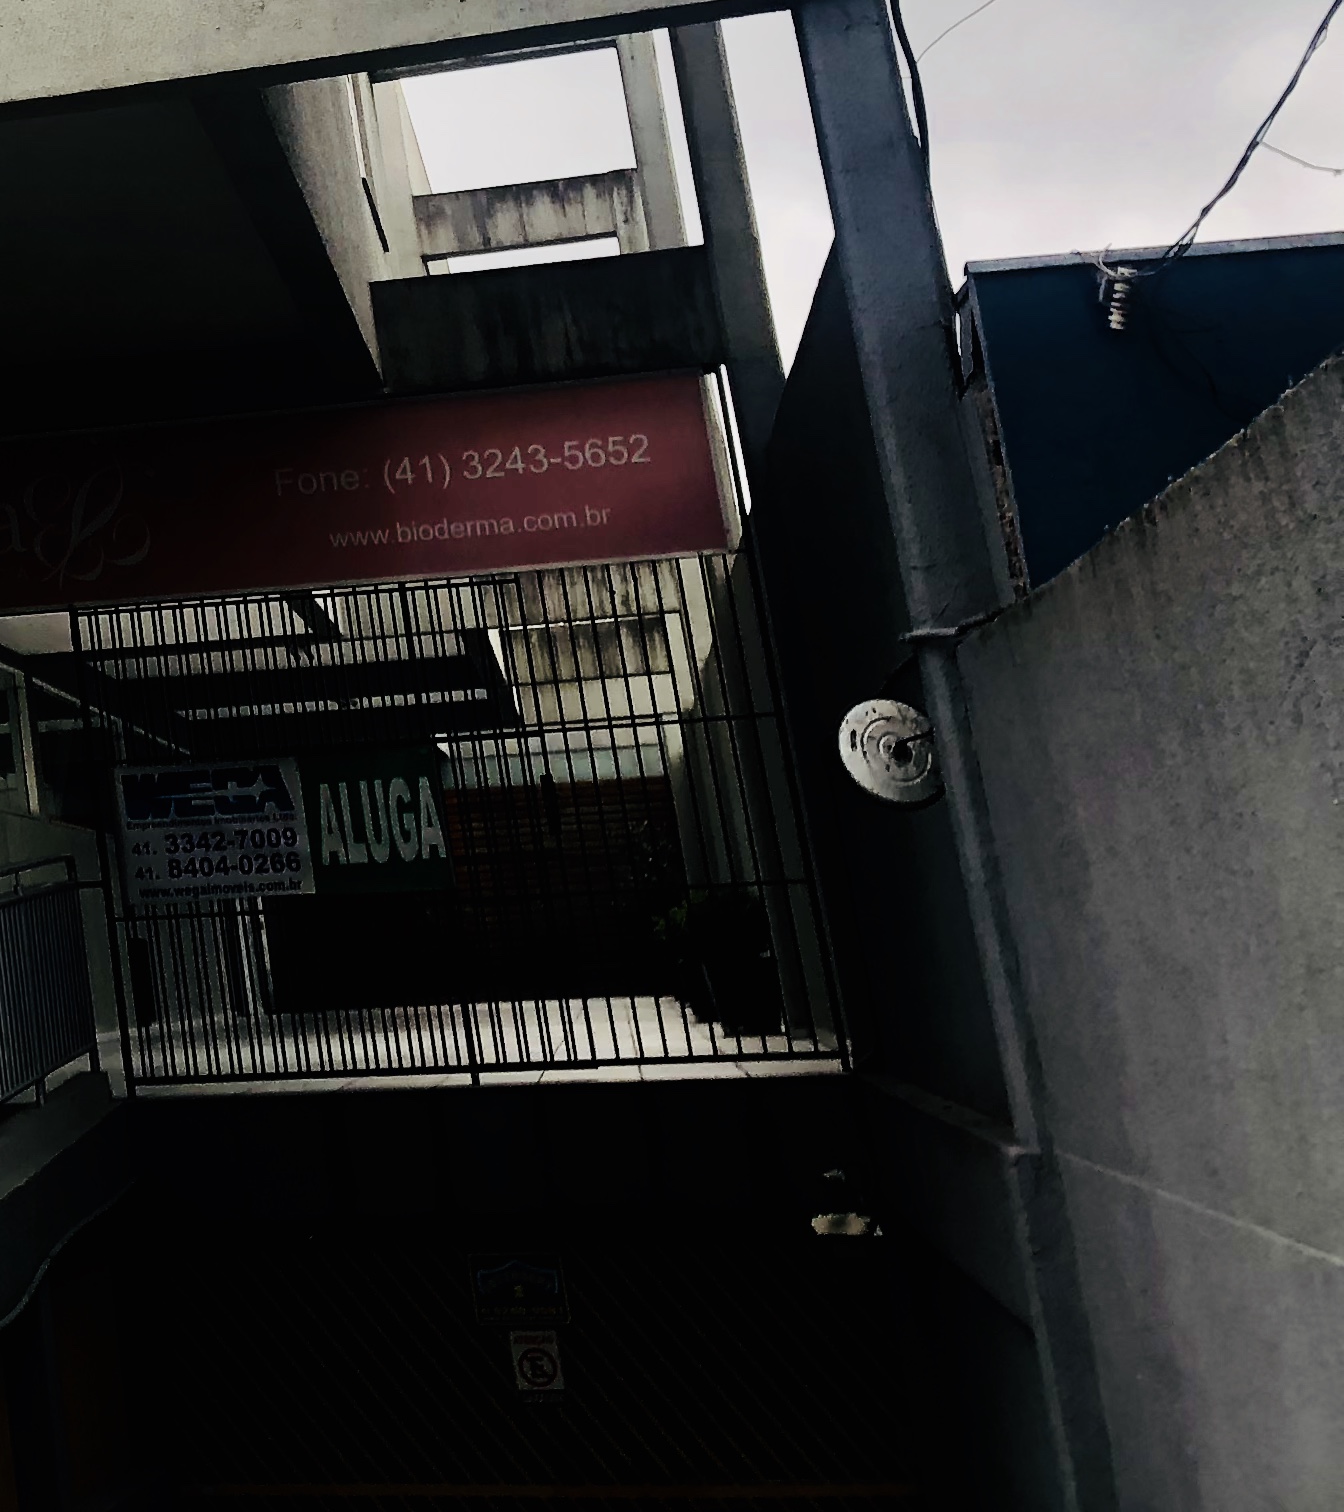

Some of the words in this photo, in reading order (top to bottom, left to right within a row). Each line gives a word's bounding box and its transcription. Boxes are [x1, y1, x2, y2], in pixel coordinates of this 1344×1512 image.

[272, 466, 370, 497] Fone:
[383, 452, 452, 494] (41)
[462, 433, 652, 481] 3243-5652
[328, 504, 612, 548] www.bioderma.com.br
[164, 826, 299, 854] 3342-7009
[318, 775, 447, 866] ALUGA
[167, 850, 302, 879] 8404-0266
